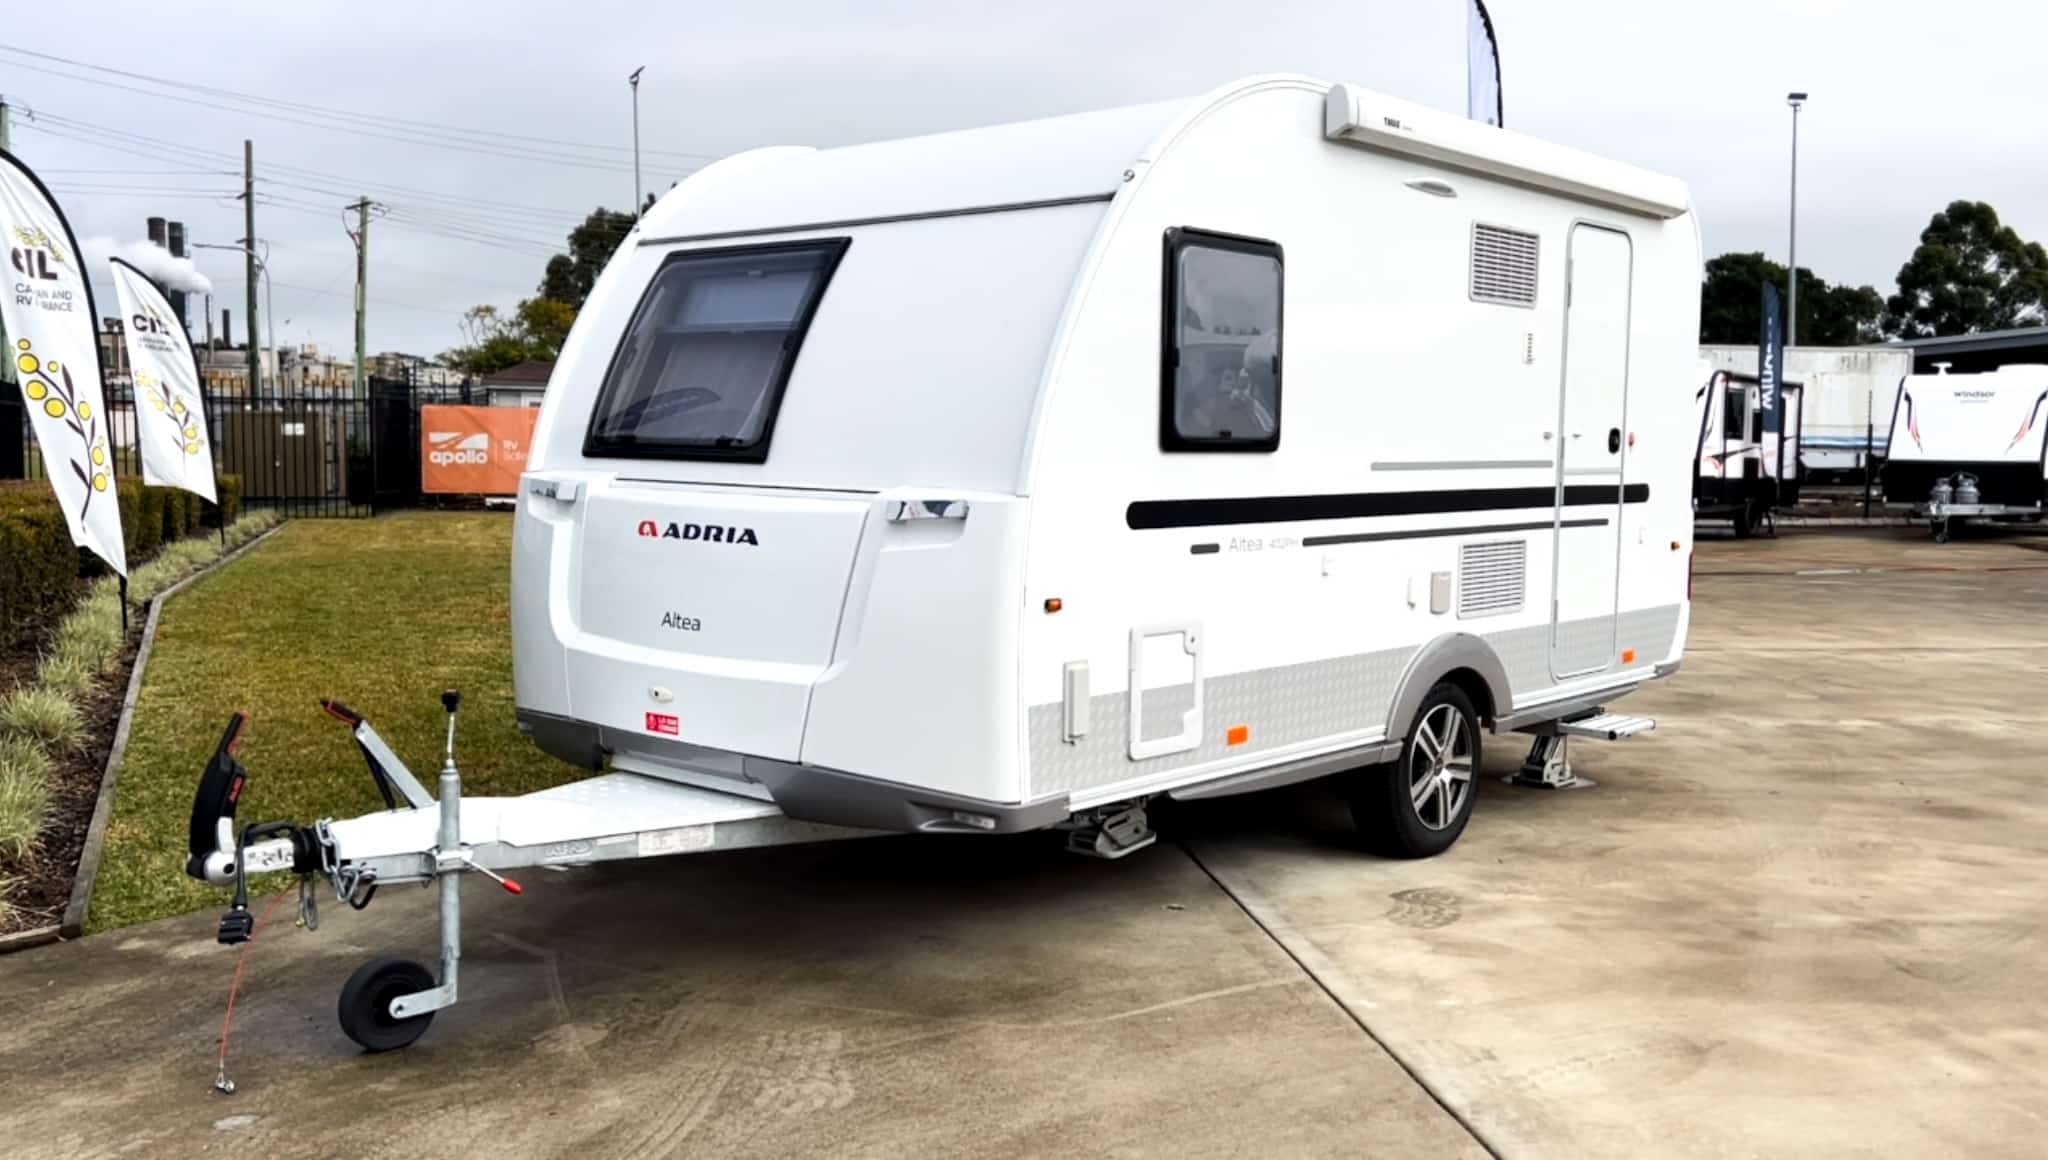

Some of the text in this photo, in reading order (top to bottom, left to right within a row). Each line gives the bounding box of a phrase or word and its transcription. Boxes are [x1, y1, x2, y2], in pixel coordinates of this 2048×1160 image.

[15, 294, 33, 306] RV
[51, 289, 73, 301] AND
[429, 448, 489, 467] apollo
[661, 521, 759, 546] ADRIA
[1228, 536, 1263, 552] Altea
[661, 611, 702, 632] Altea
